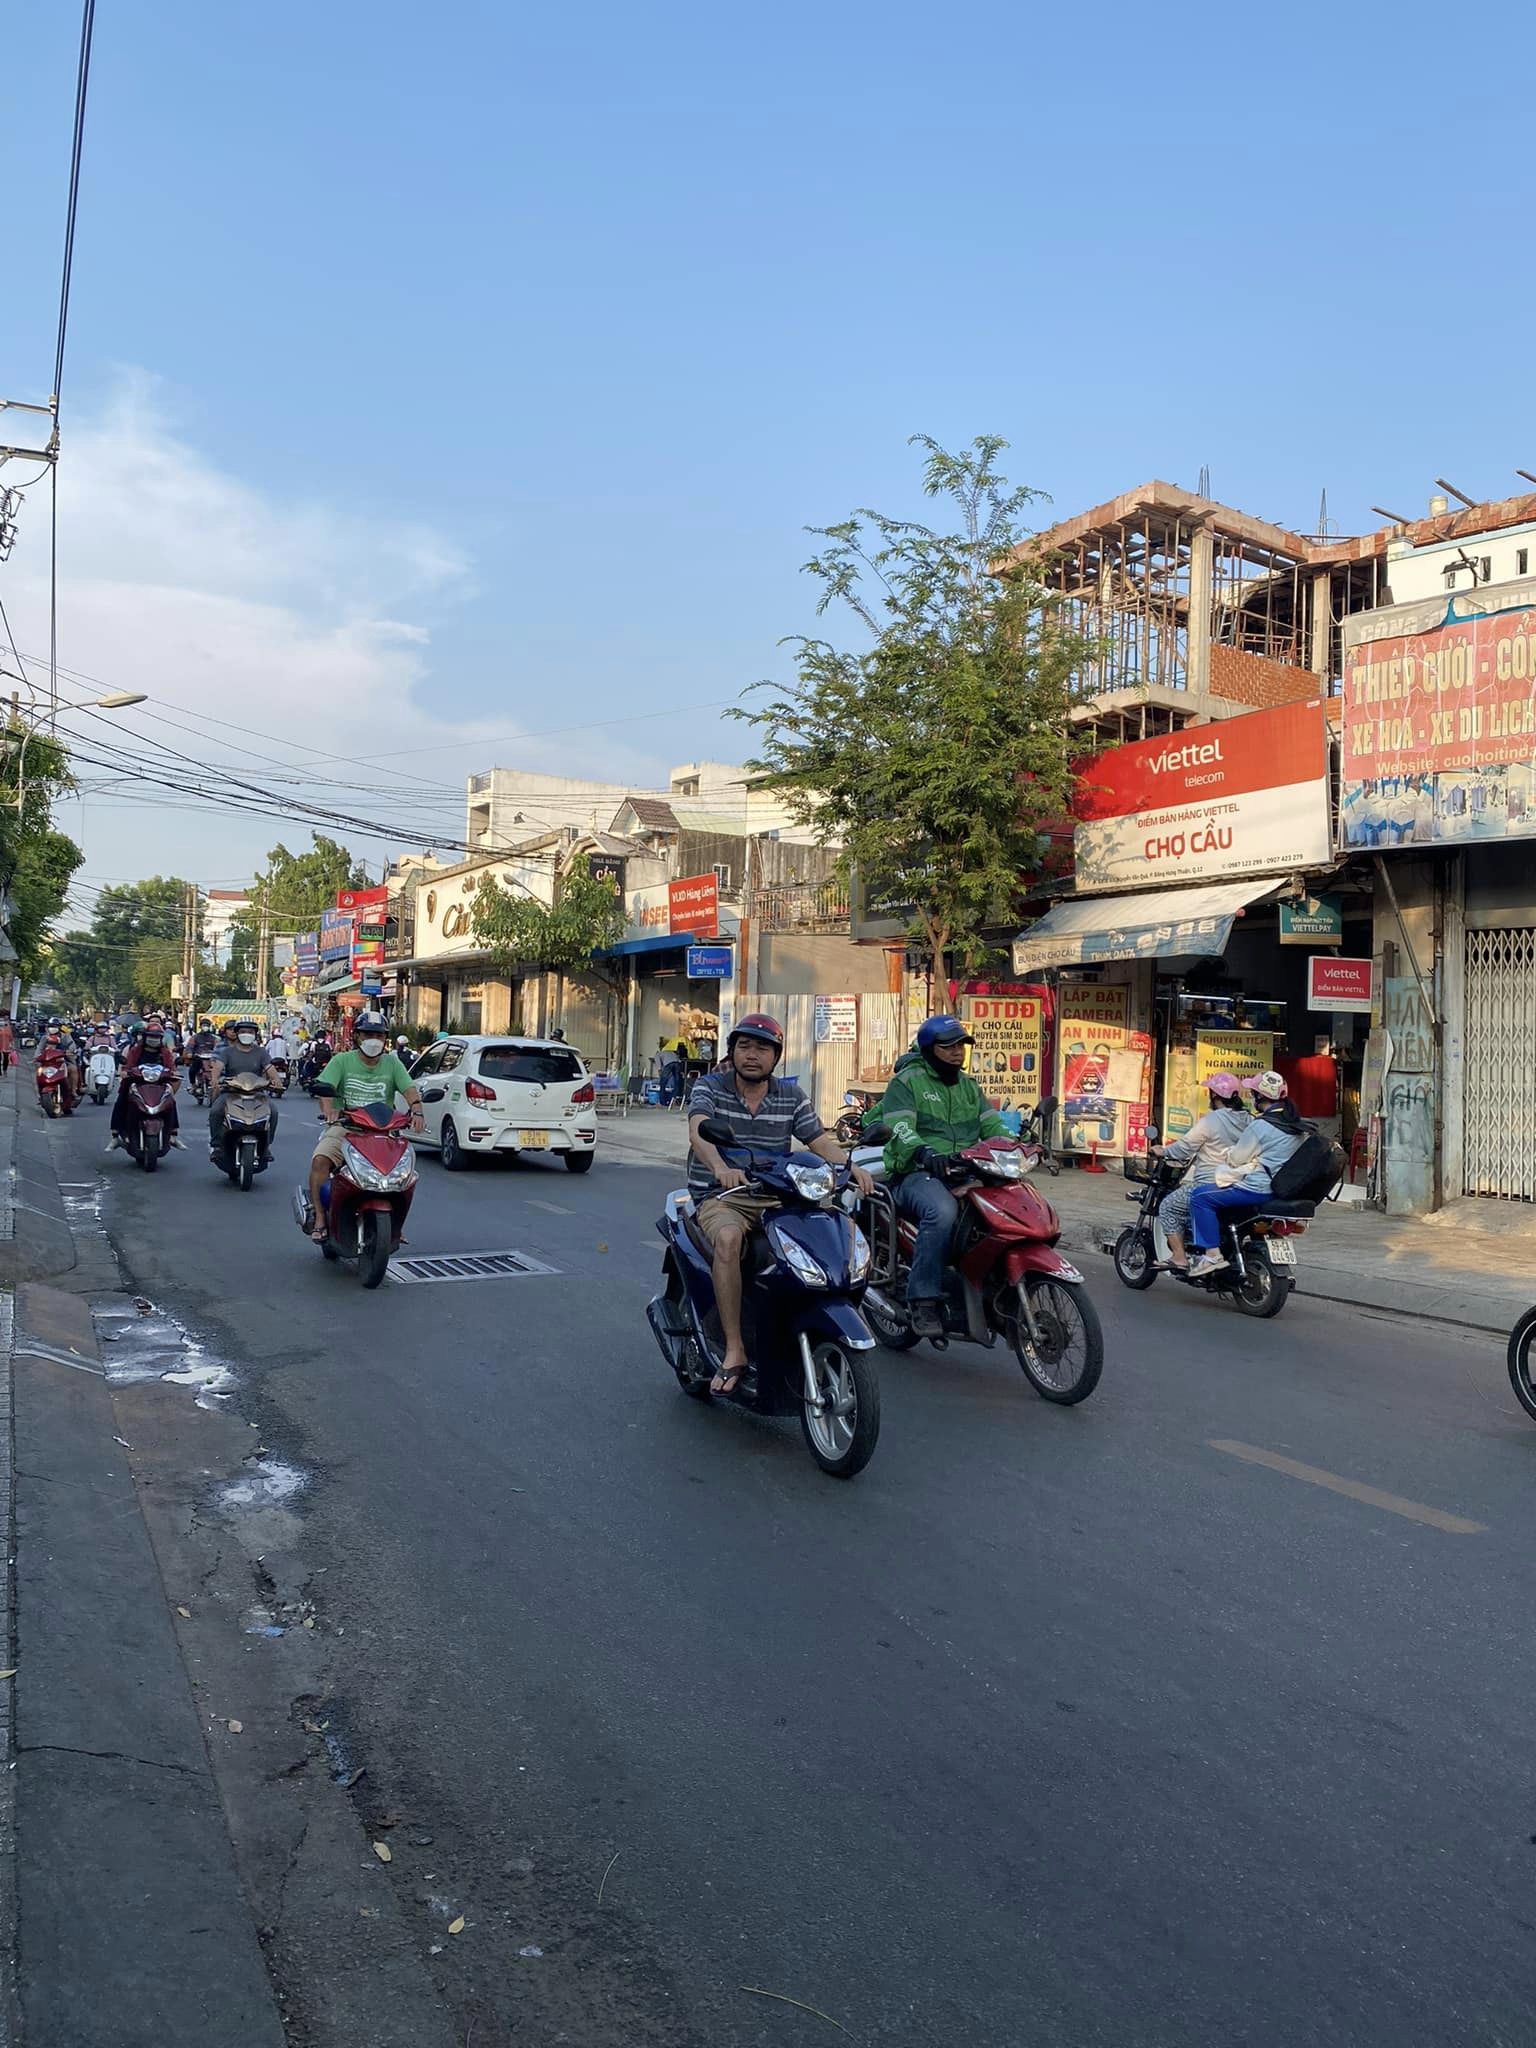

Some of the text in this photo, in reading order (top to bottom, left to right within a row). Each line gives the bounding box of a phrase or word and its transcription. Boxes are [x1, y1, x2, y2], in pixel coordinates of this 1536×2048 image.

[1352, 647, 1415, 710] THIỆP
[1422, 635, 1474, 693] CƯỚI
[1352, 723, 1374, 756] XE
[1379, 717, 1414, 752] HOA
[1430, 710, 1454, 746] XE
[1459, 705, 1484, 742] DU
[1489, 697, 1535, 745] LỊCH
[1148, 738, 1224, 775] viettel
[1376, 756, 1440, 775] Website:
[1184, 771, 1225, 788] telecom
[1137, 802, 1240, 829] ĐIỂM BÁN HÀNG VIETTEL
[1145, 818, 1233, 860] CHỢ CẦU
[1292, 924, 1332, 933] VIETTELPAY
[1324, 968, 1361, 980] viettel
[1344, 986, 1366, 994] VIETTEL
[1063, 1008, 1124, 1022] CAMERA
[1000, 1031, 1013, 1040] SIM
[1063, 1026, 1122, 1040] AN NINH
[1028, 1075, 1038, 1084] ĐT
